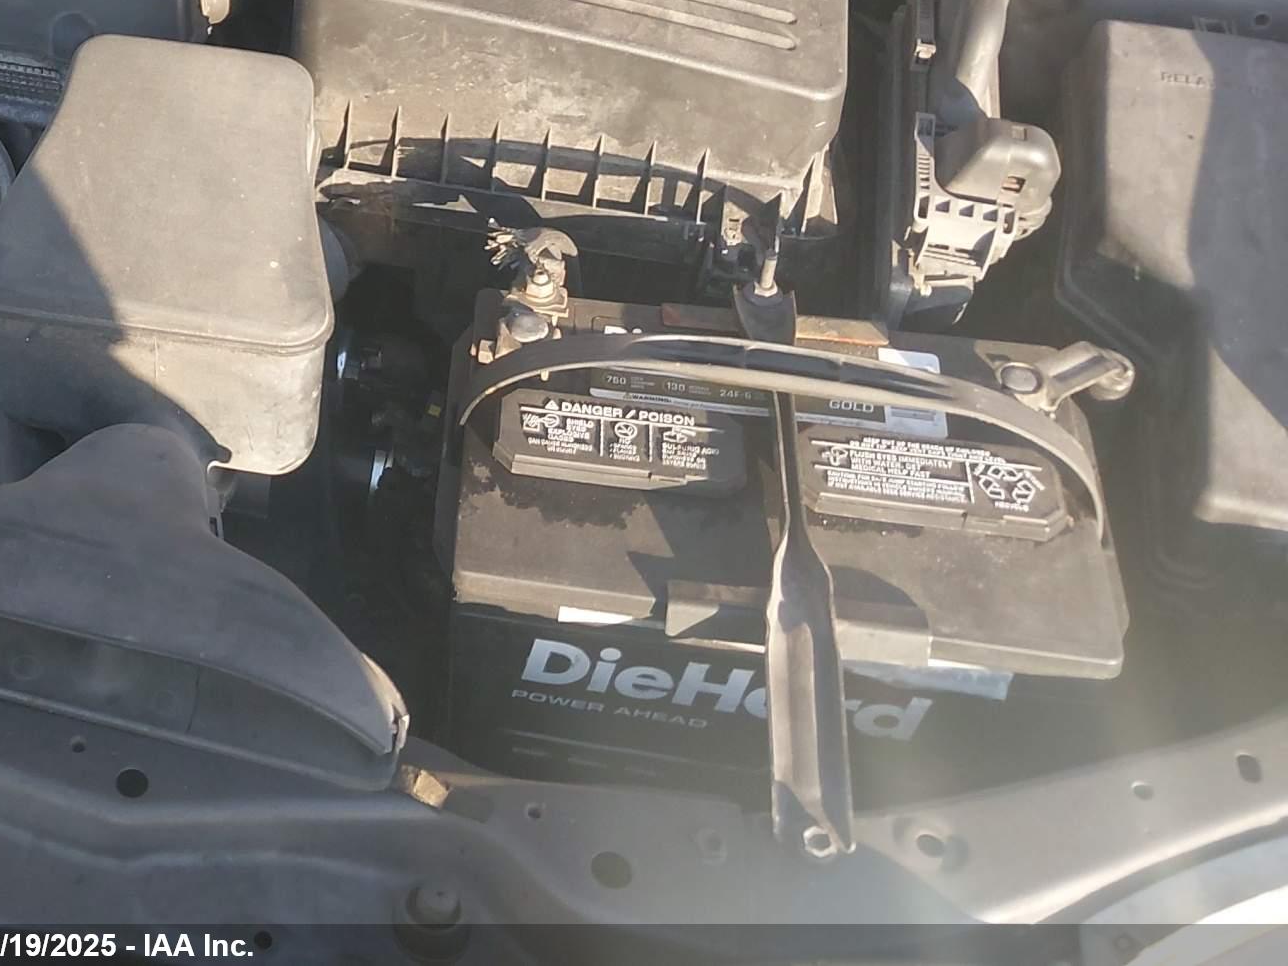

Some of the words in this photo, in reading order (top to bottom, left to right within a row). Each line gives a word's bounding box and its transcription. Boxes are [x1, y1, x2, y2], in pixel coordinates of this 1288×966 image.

[561, 401, 622, 419] DANGER
[638, 411, 696, 427] POISON
[828, 400, 874, 414] GOLD
[521, 638, 933, 741] DieHd
[511, 689, 604, 713] POWER
[614, 706, 708, 729] AHEAD
